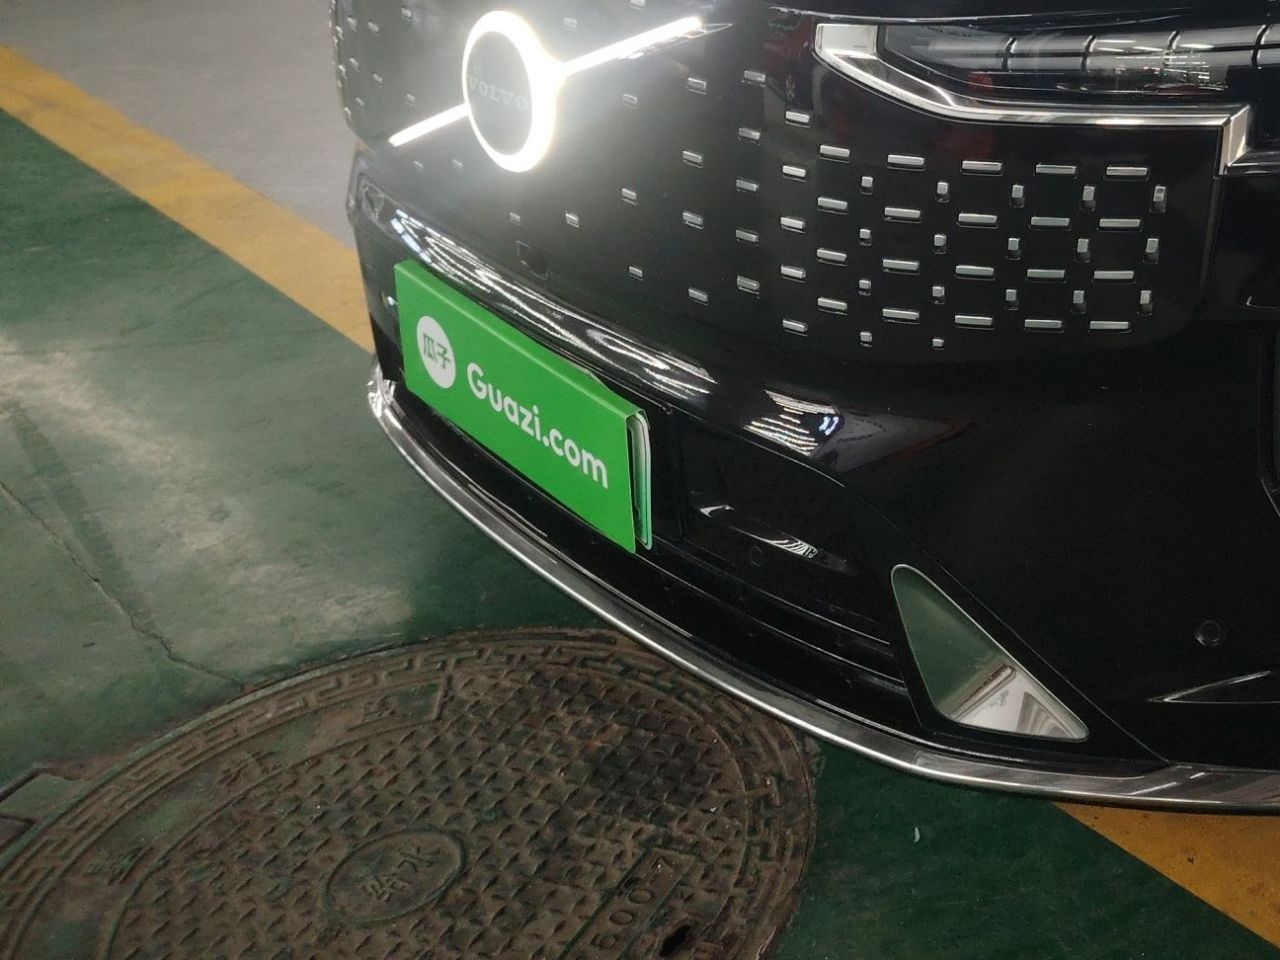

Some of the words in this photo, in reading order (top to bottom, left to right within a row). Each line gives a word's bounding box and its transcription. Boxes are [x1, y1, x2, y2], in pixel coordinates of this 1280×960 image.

[469, 77, 528, 111] VOLVO
[422, 332, 452, 371] 瓜子
[466, 362, 609, 490] Guazi.com
